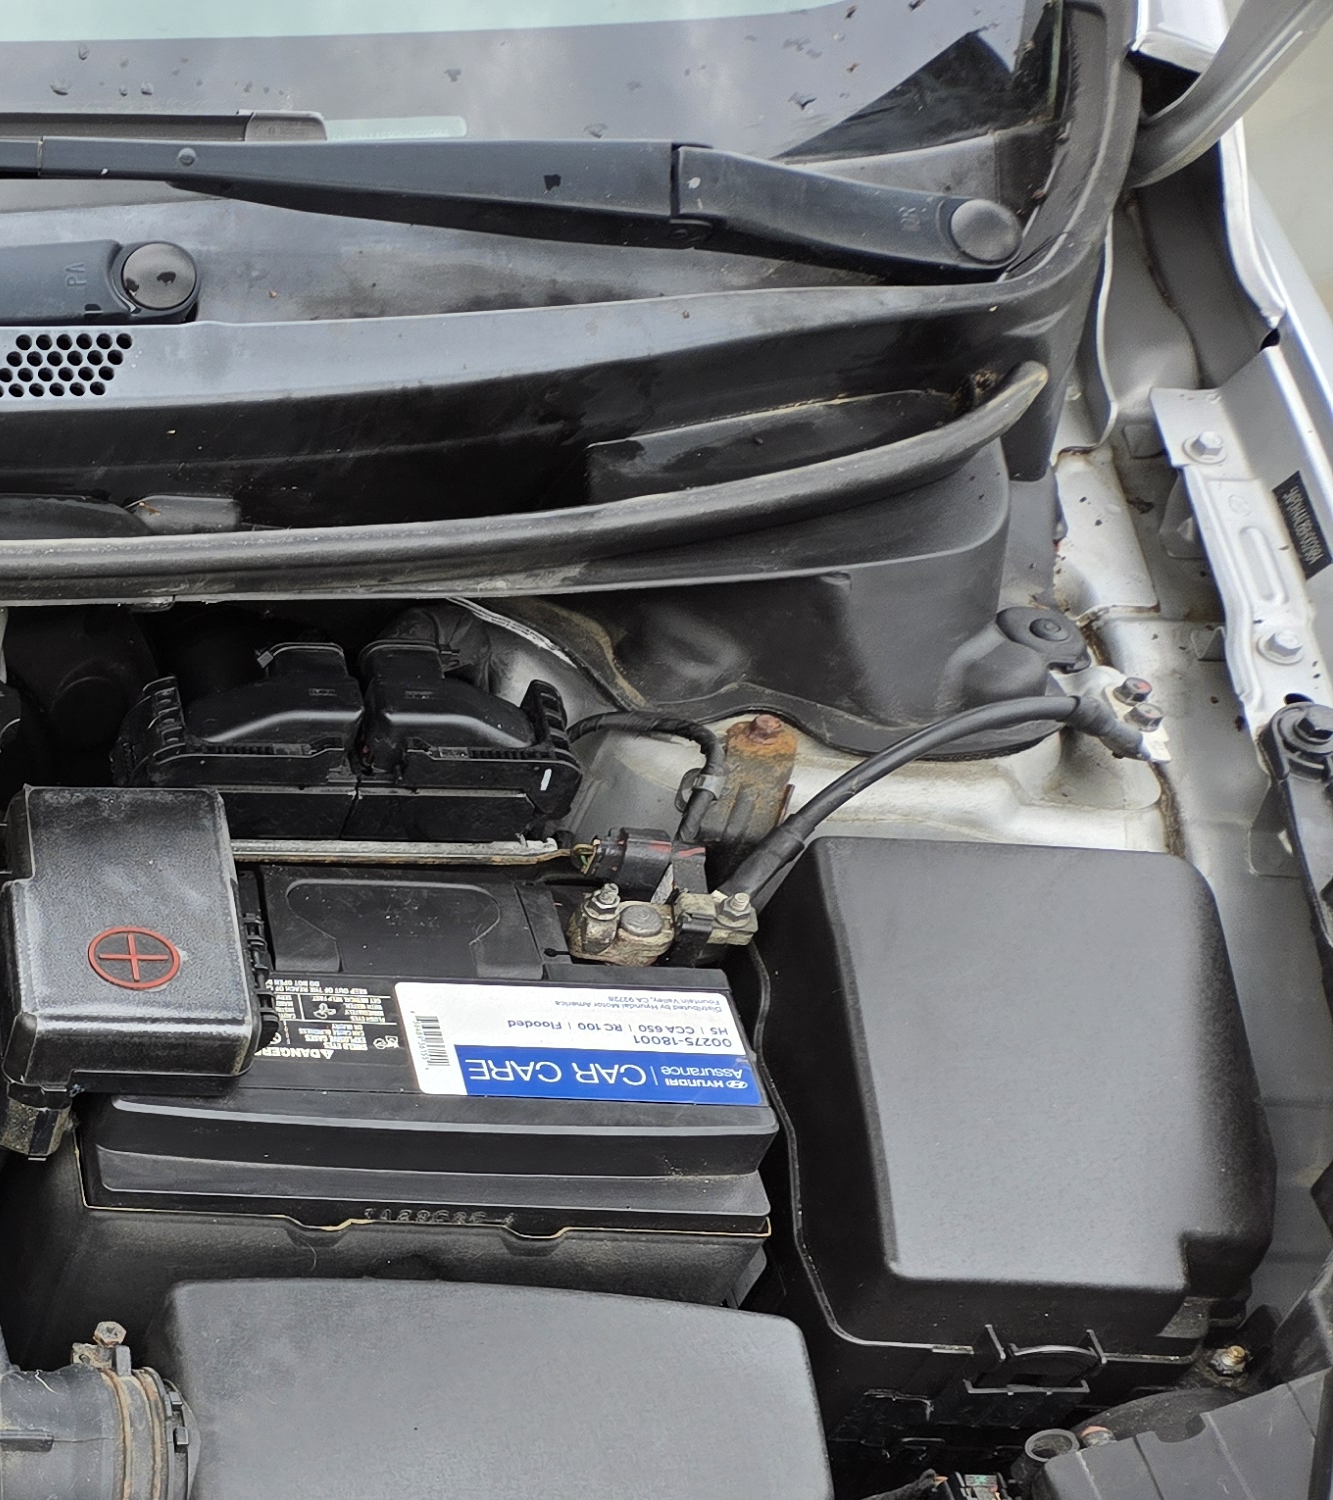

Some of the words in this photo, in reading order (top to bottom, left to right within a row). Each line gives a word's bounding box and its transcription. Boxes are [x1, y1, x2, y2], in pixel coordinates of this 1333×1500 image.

[554, 1000, 592, 1008] America
[635, 996, 648, 1004] CA
[683, 998, 721, 1006] Fountain
[594, 1001, 620, 1009] Motor
[621, 1001, 658, 1010] Hyundai
[673, 1004, 723, 1013] Distributed
[507, 1019, 562, 1030] Flooded
[577, 1022, 601, 1031] 100
[603, 1022, 622, 1031] RC
[638, 1024, 664, 1033] 650
[665, 1024, 695, 1034] CCA
[709, 1026, 729, 1035] H5
[632, 1034, 733, 1048] 00275-18001
[464, 1059, 562, 1083] CARE
[571, 1061, 647, 1086] CAR
[660, 1065, 743, 1079] Assurance
[664, 1077, 724, 1088] HYUNDAI
